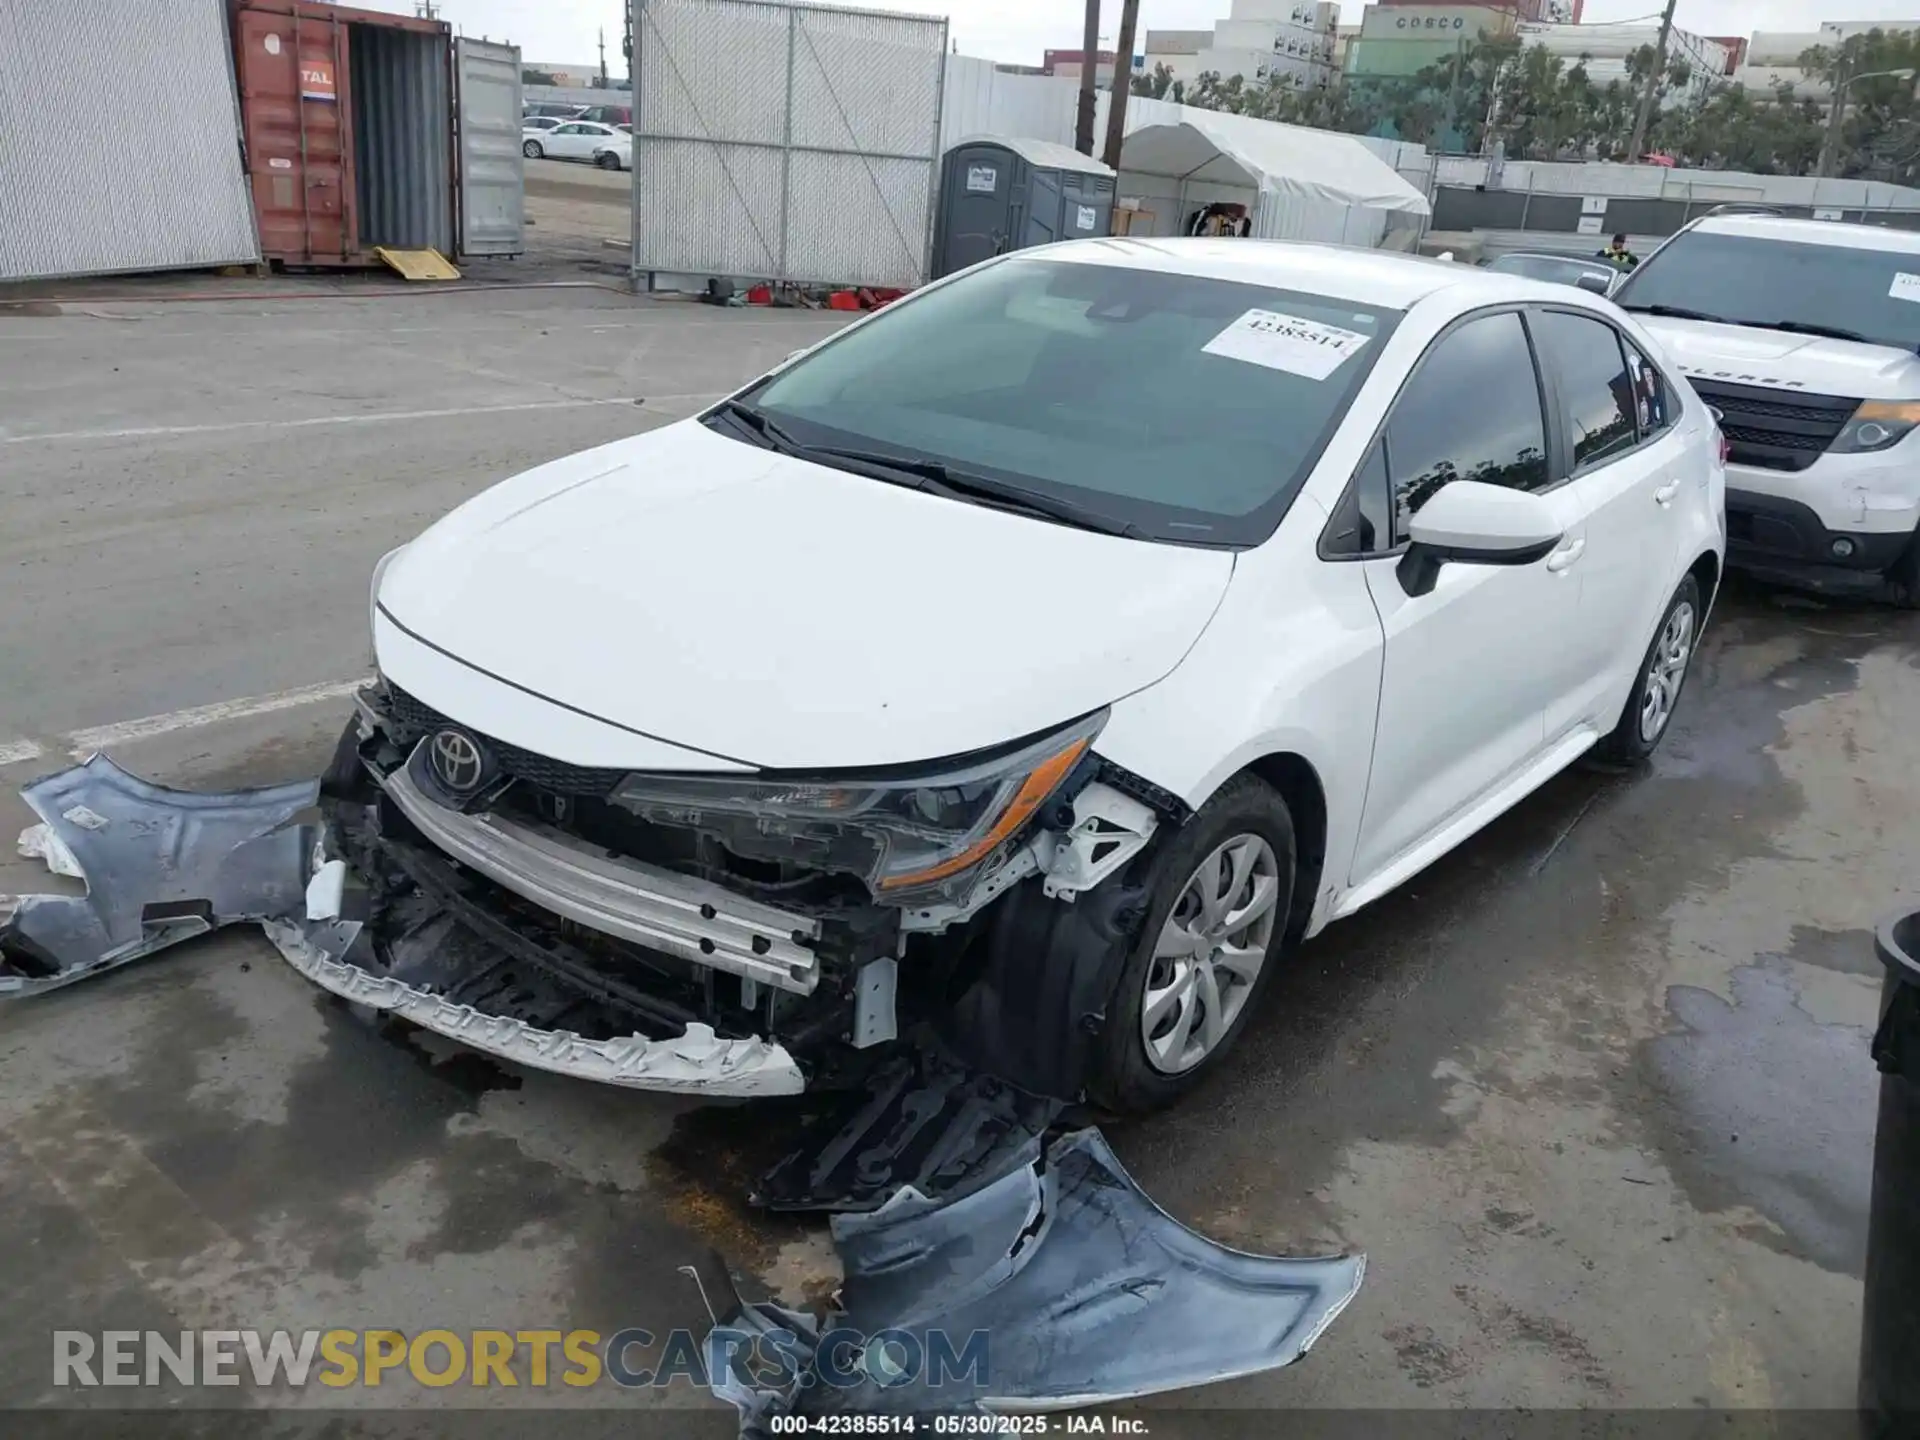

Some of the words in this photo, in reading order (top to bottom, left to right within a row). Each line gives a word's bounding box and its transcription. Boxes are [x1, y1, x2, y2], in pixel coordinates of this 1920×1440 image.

[1395, 16, 1463, 30] COSCO
[301, 69, 333, 85] TAL
[1247, 319, 1344, 349] 42385514
